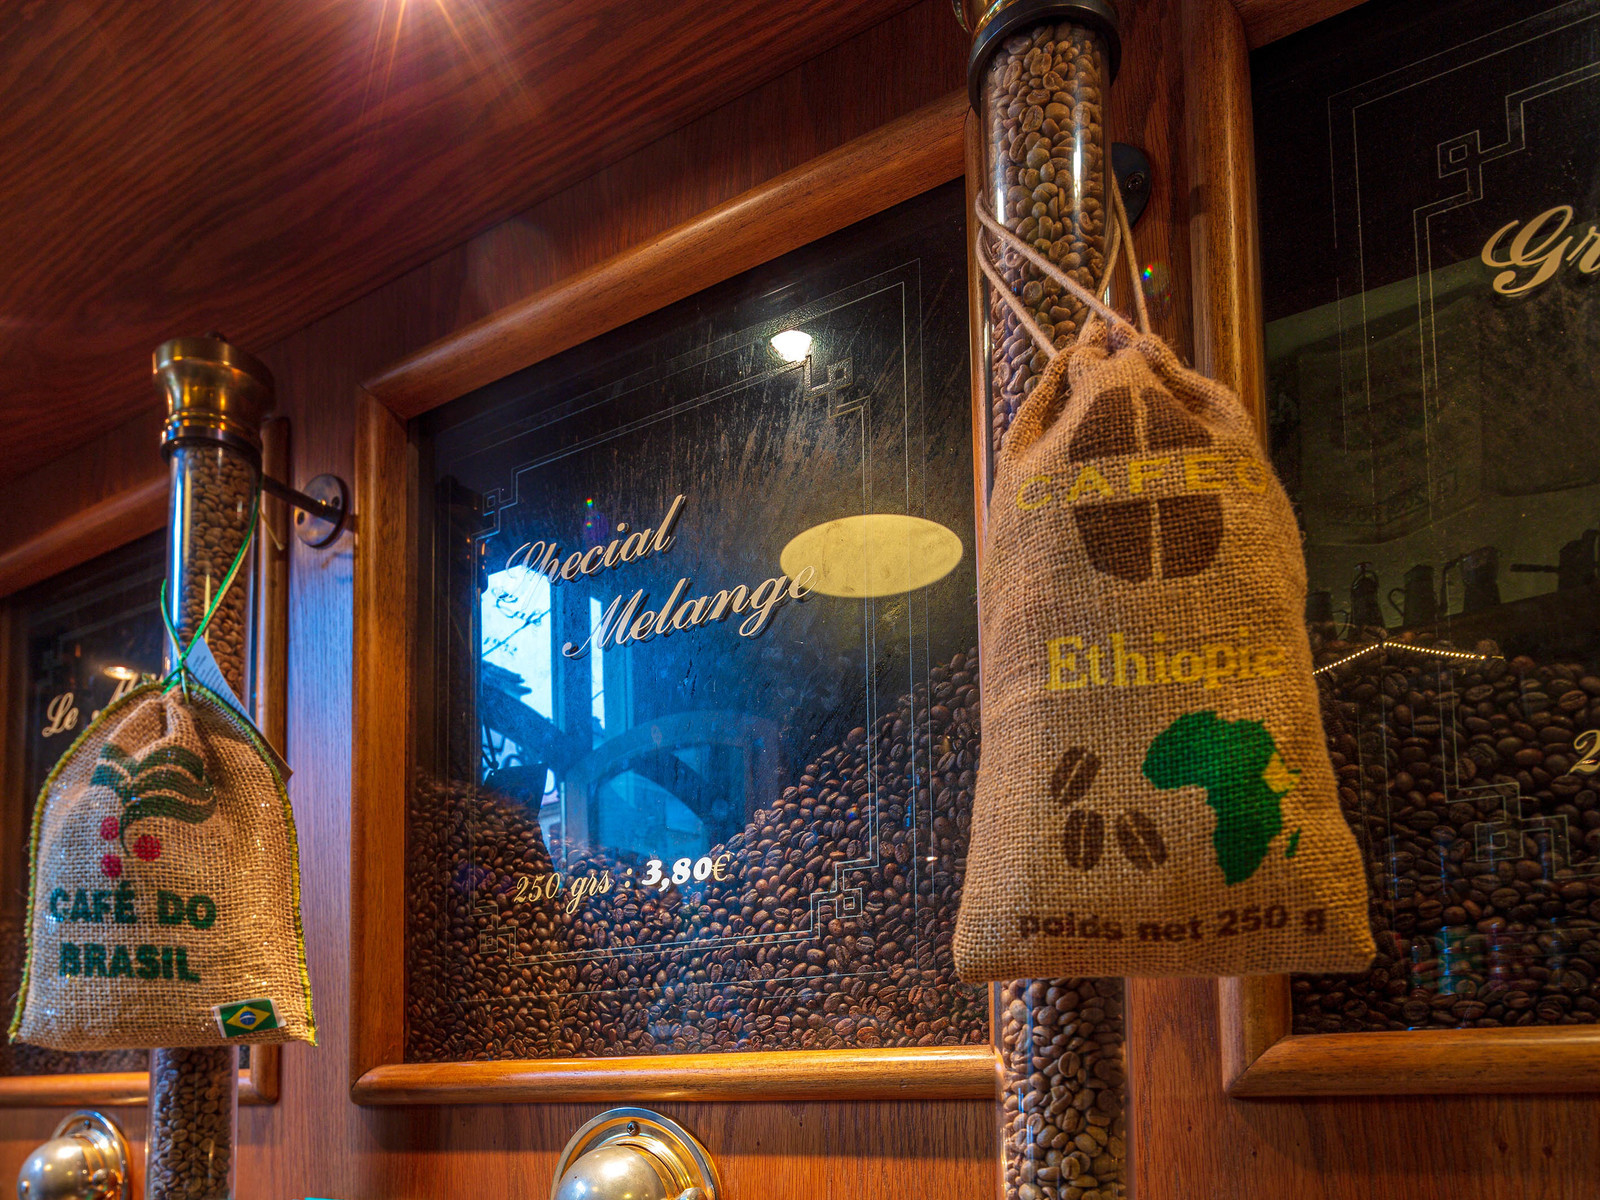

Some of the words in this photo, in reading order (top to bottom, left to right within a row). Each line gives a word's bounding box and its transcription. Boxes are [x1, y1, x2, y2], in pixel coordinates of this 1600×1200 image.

[505, 494, 685, 600] Special
[562, 565, 816, 658] Melange
[1045, 626, 1286, 690] Ethiopie
[42, 692, 80, 738] Le
[50, 881, 137, 923] CAFÉ
[156, 890, 217, 930] DO
[514, 873, 561, 903] 250
[566, 869, 613, 915] grs
[641, 853, 731, 892] 3,80€
[1019, 911, 1124, 940] poids
[1137, 918, 1203, 942] net
[1216, 904, 1288, 937] 250
[1302, 906, 1328, 936] g
[59, 943, 201, 983] BRASIL
